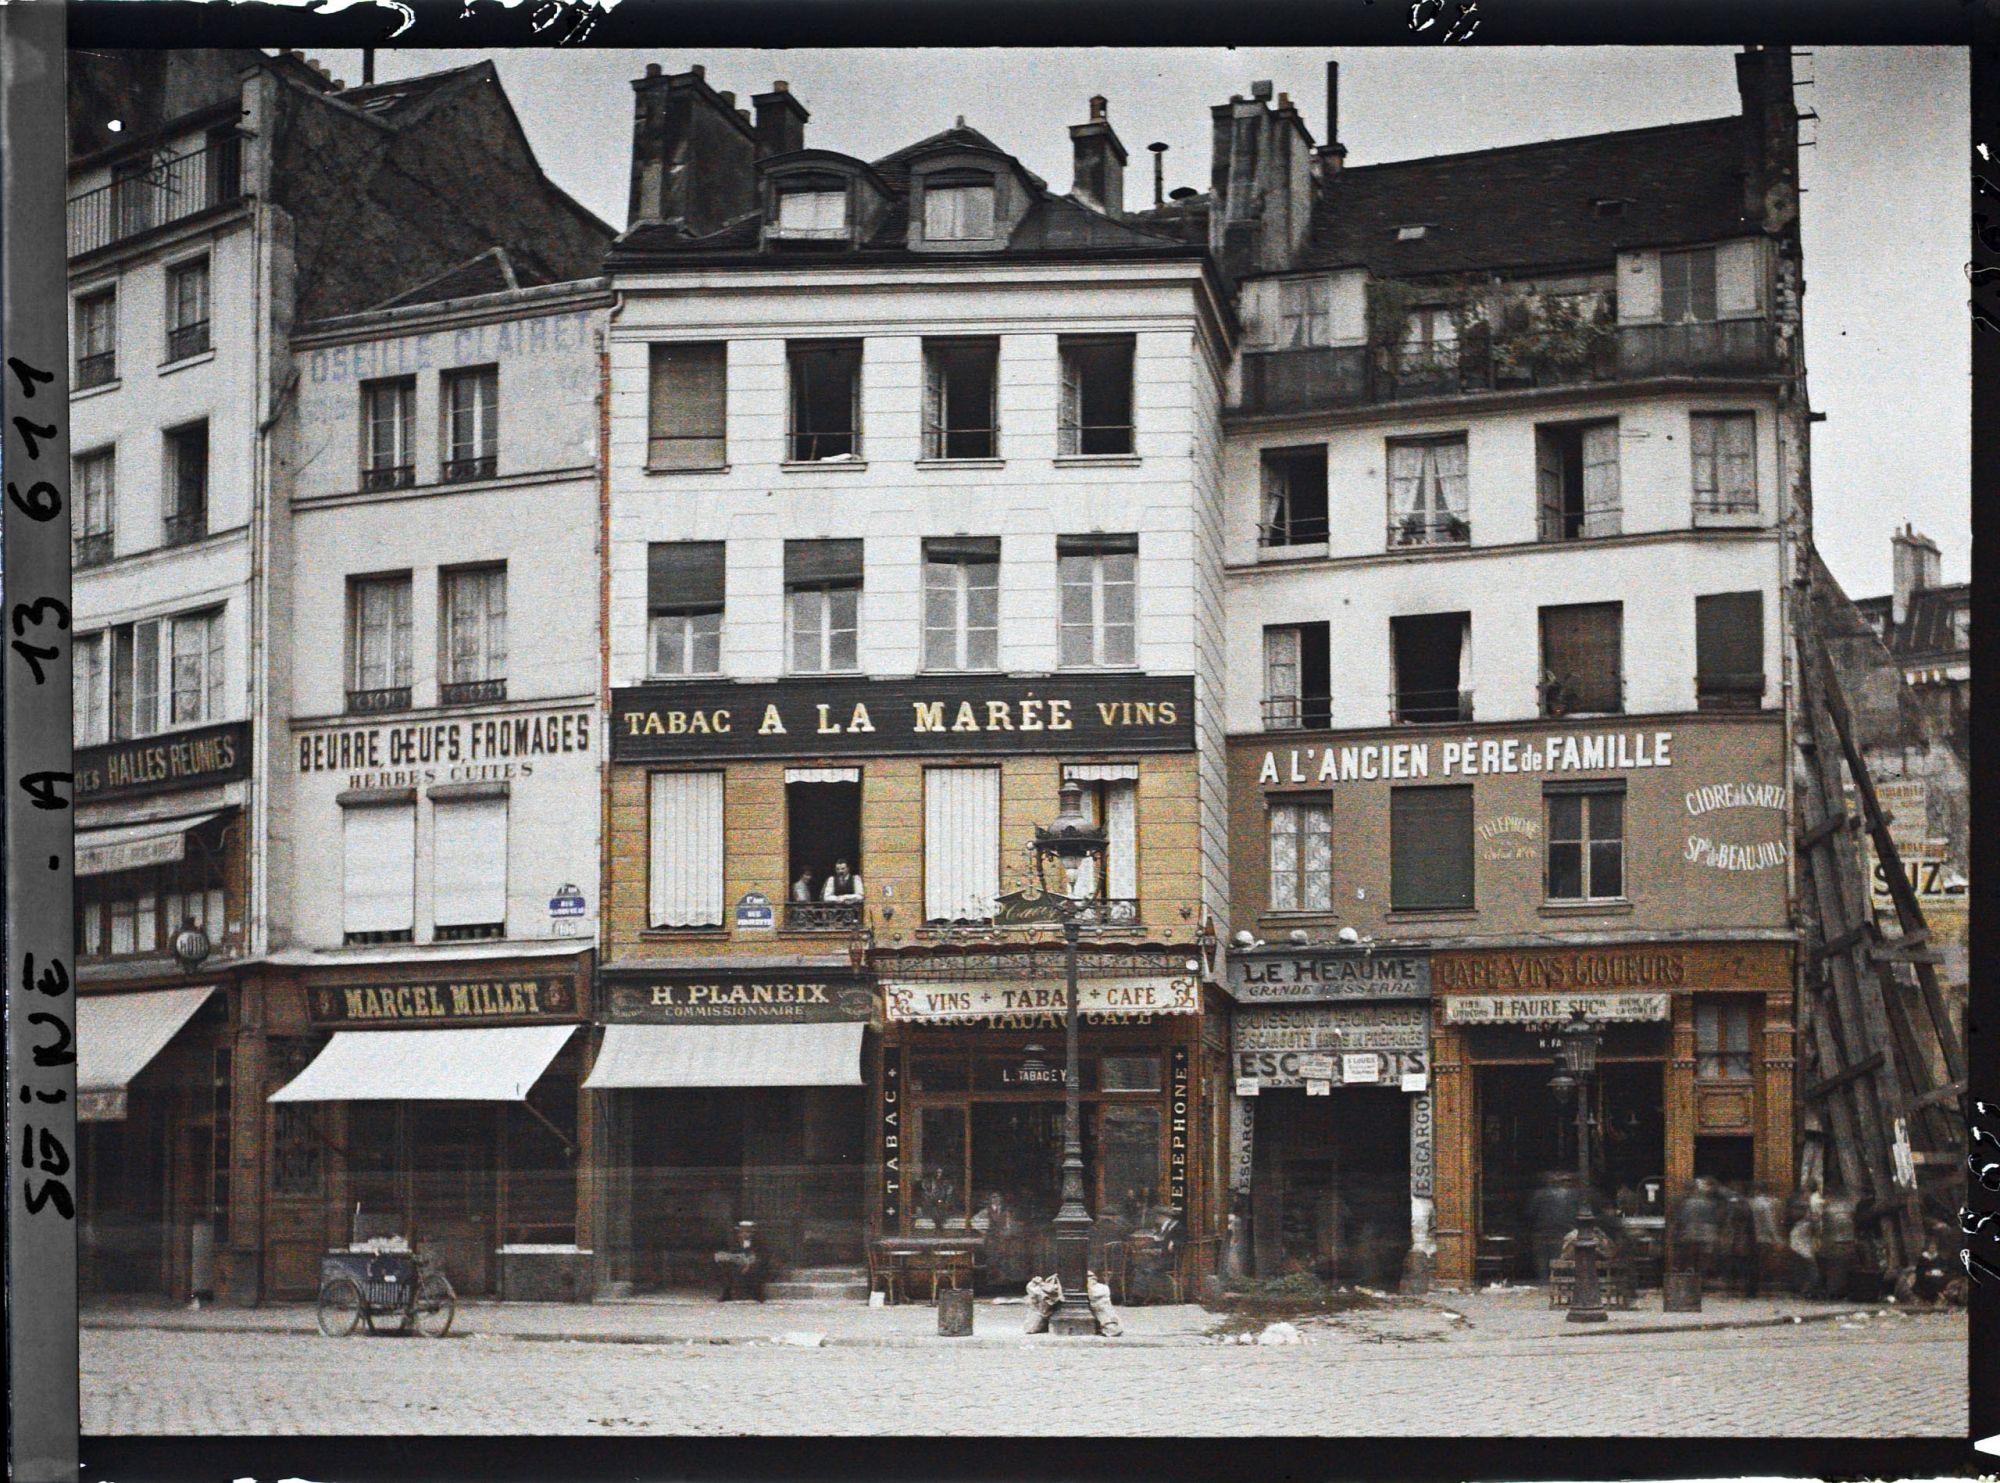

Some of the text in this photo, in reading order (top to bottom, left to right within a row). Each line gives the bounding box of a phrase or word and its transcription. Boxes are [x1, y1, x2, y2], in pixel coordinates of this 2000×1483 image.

[11, 596, 70, 685] 13
[624, 690, 1179, 736] TABAC A LA MARÉE VINS
[299, 729, 385, 773] BEURRE,
[471, 713, 590, 759] FROMAGES
[1259, 732, 1672, 784] A L'ANCIEN PÈRE de FAMILLE
[107, 746, 167, 787] HALLES
[349, 762, 534, 789] HERBES CUITES
[1686, 783, 1733, 816] CIDRE
[1717, 839, 1788, 871] BEAUJOLA
[1243, 959, 1417, 984] LE HEAUME
[344, 982, 540, 1018] MARCEL MILLET
[651, 985, 682, 1006] H.
[688, 984, 830, 1006] PLANEIX
[926, 992, 971, 1012] VINS
[1002, 988, 1080, 1009] TABA
[1249, 984, 1313, 997] GRANDE
[665, 1005, 805, 1018] COMMISSIONNAIRE
[1236, 1010, 1315, 1030] CUISSON
[1510, 1000, 1561, 1016] FAURE
[1003, 1069, 1015, 1082] L.
[885, 1091, 899, 1193] TABAC
[1171, 1067, 1188, 1213] TELEPHONE
[1239, 1101, 1254, 1191] ESCARGO
